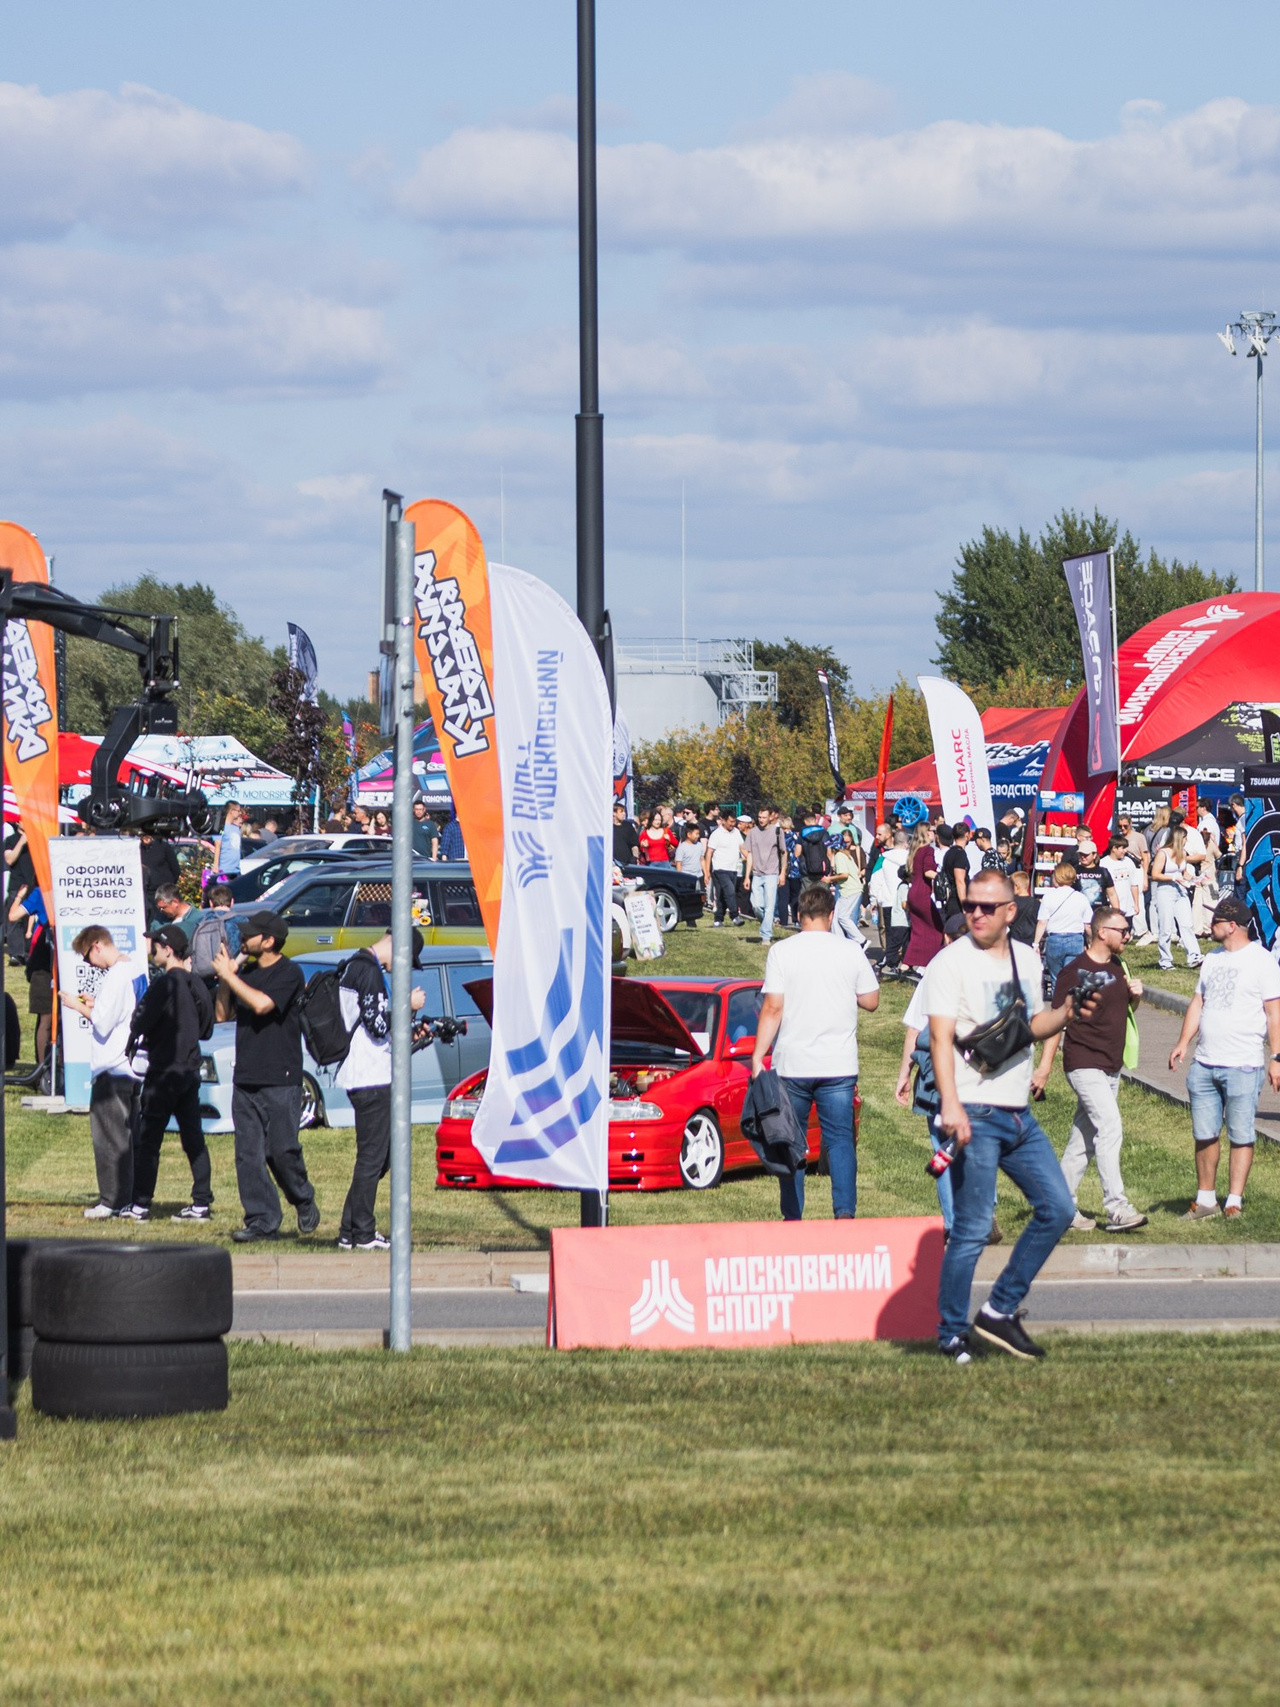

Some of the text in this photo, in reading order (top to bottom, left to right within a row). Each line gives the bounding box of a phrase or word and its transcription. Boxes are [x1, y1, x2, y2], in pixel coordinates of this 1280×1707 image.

[1133, 630, 1194, 670] СПОРТ
[1115, 630, 1218, 726] МОСКОВСКИЙ
[951, 728, 969, 807] LEMARC
[1250, 777, 1280, 786] TSUNAMI
[243, 790, 292, 799] MOTORSPO
[989, 783, 1038, 798] ЗВОДСТВО
[66, 865, 125, 875] ОФОРМИ
[59, 877, 133, 888] ПРЕДЗАКАЗ
[66, 889, 127, 899] НА ОБВЕС
[88, 906, 136, 918] Sports
[705, 1245, 892, 1293] МОСКОВСКИЙ
[707, 1293, 795, 1334] СПОРТ
